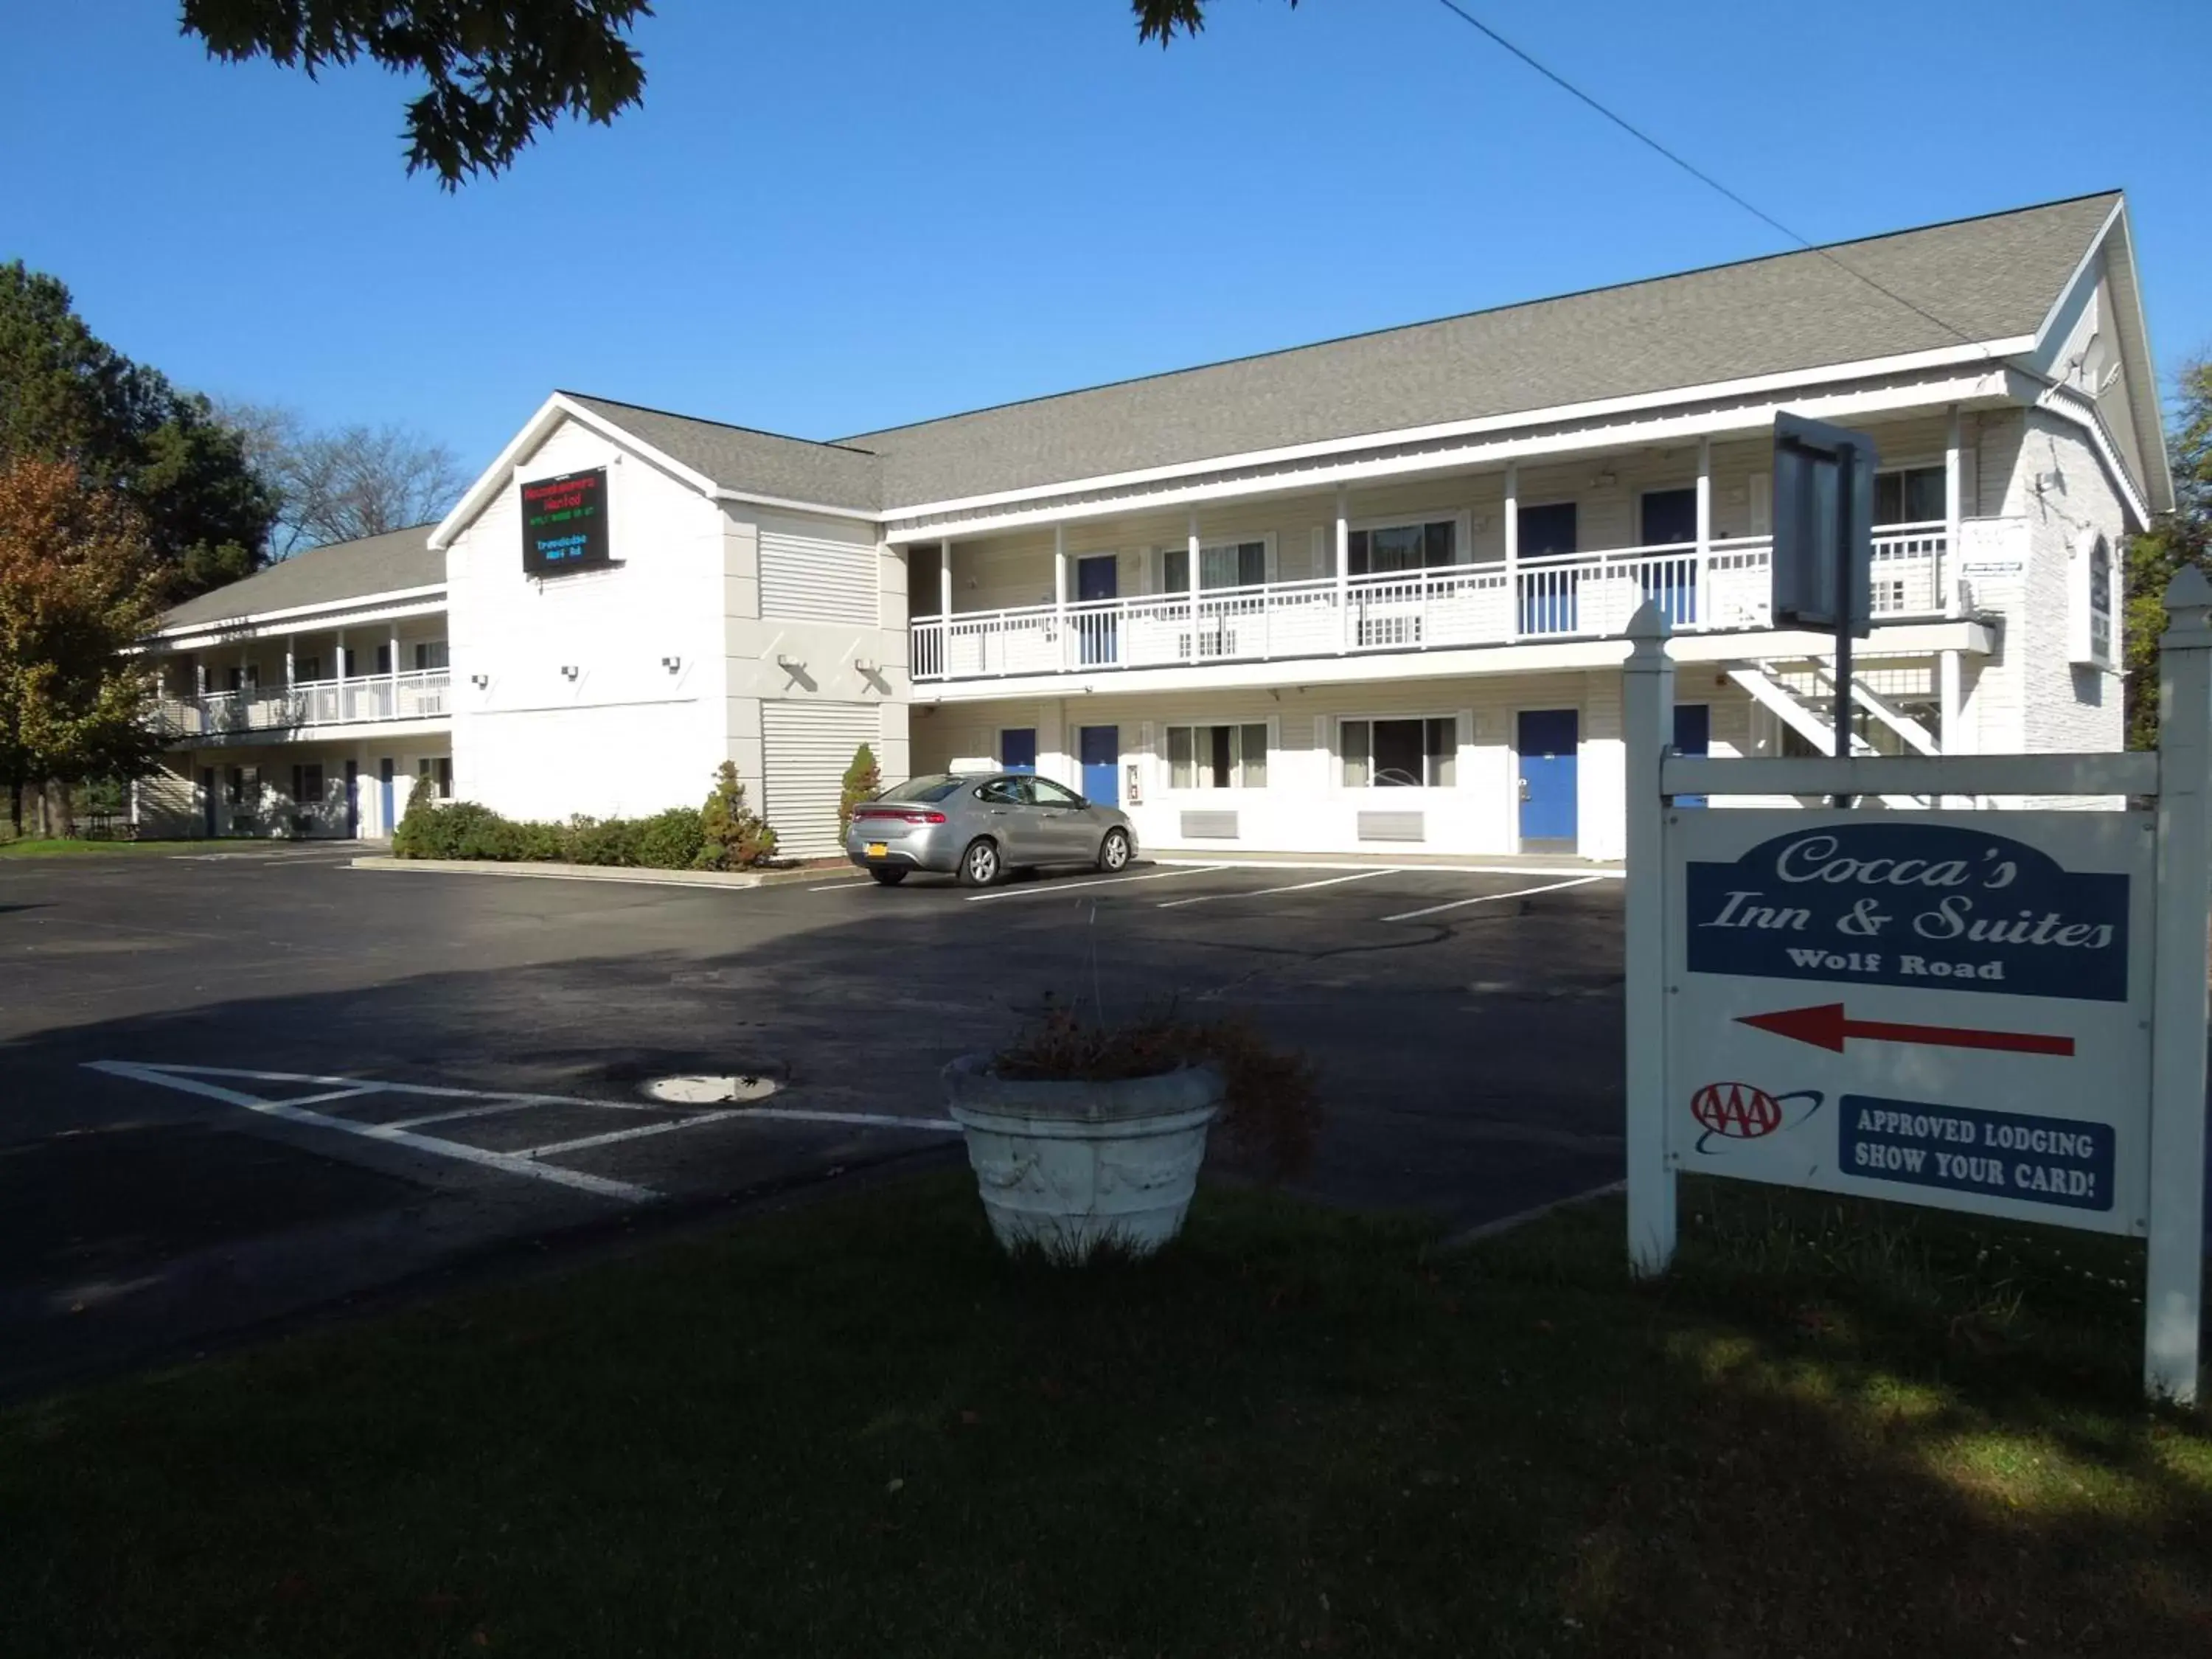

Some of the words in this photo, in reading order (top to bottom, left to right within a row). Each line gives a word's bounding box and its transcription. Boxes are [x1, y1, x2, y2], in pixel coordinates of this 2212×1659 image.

[1775, 835, 2018, 888] Cocca's
[1699, 891, 1810, 931] Inn
[1837, 897, 1893, 936] &
[1913, 895, 2114, 949] Suites
[1787, 948, 1882, 973] Wolf
[1899, 955, 2006, 981] Road
[1703, 1085, 1775, 1137] AAA
[1857, 1110, 1976, 1144] APPROVED
[1985, 1124, 2094, 1158] LODGING
[1854, 1143, 1928, 1172] SHOW
[1935, 1152, 2005, 1182] YOUR
[2014, 1165, 2096, 1198] CARD!
